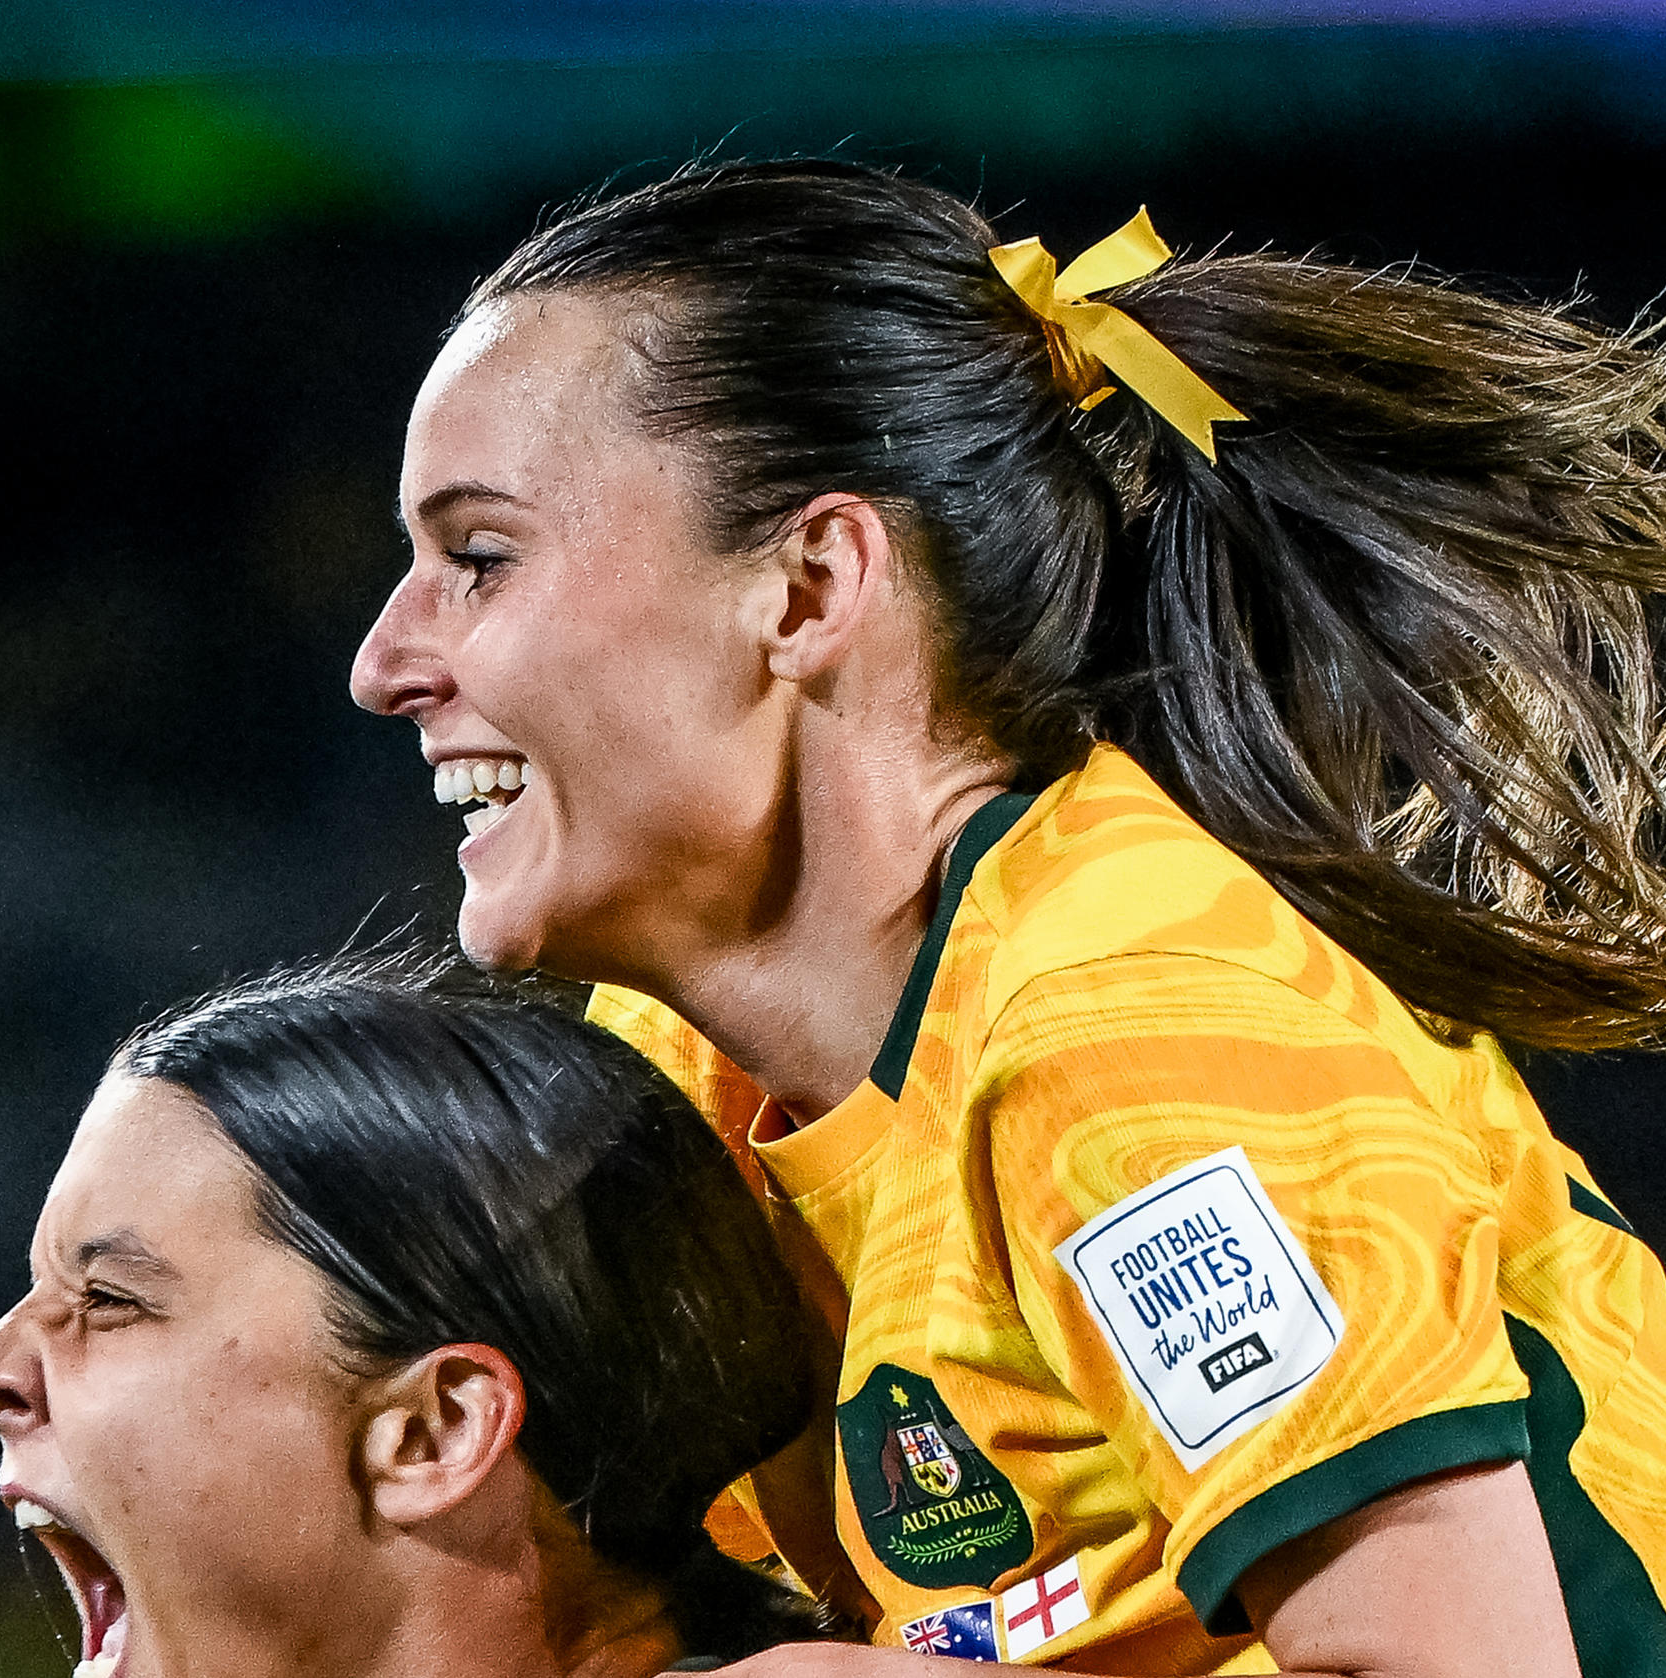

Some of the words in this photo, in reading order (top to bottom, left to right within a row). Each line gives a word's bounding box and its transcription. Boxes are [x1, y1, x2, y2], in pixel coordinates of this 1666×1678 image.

[1110, 1206, 1231, 1290] FOOTBALL
[1129, 1237, 1253, 1329] UNITES
[1151, 1329, 1195, 1371] the
[1190, 1274, 1280, 1343] World
[1208, 1342, 1264, 1384] FIFA
[901, 1490, 1002, 1535] AUSTRALIA
